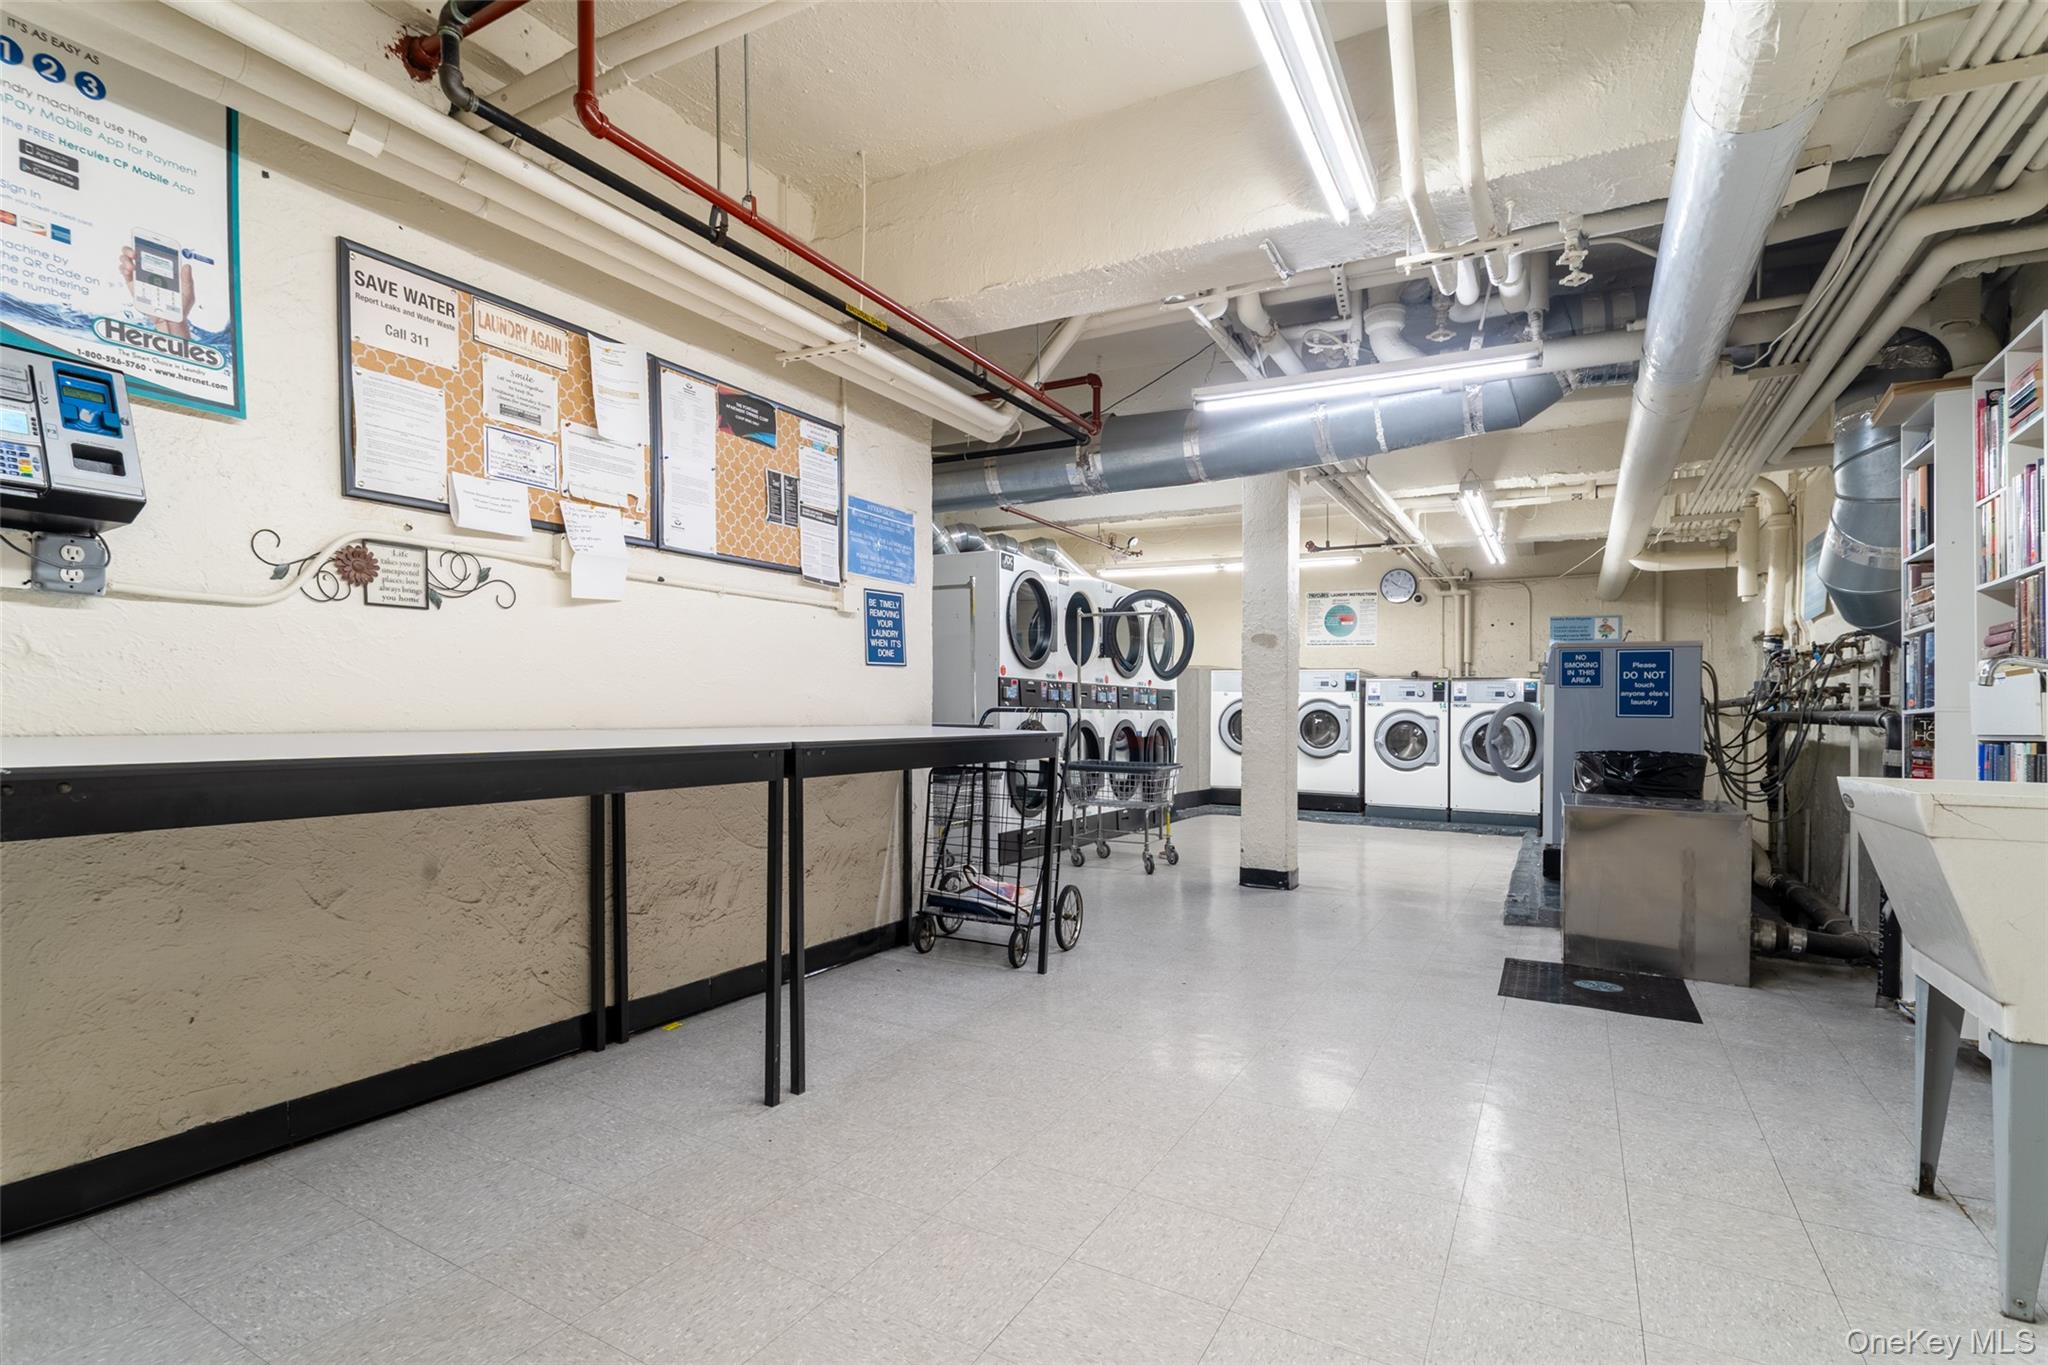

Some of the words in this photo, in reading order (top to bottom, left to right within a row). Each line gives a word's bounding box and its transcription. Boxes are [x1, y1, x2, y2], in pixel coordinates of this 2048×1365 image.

[7, 17, 28, 33] IT'S
[31, 30, 48, 42] AS
[50, 36, 81, 56] EASY
[84, 53, 100, 65] AS
[40, 58, 58, 81] 2
[81, 76, 99, 97] 3
[36, 94, 100, 124] machines
[103, 120, 125, 134] use
[128, 129, 148, 143] the
[40, 108, 93, 137] Mobile
[98, 133, 125, 149] App
[127, 142, 143, 156] for
[146, 150, 198, 177] Payment
[27, 125, 55, 143] FREE
[58, 137, 110, 164] Hercules
[113, 158, 128, 169] CP
[132, 165, 169, 186] Mobile
[172, 181, 196, 196] App
[53, 253, 69, 267] by
[23, 256, 42, 270] QR
[46, 263, 81, 281] Code
[85, 276, 100, 287] on
[23, 281, 72, 301] number
[38, 274, 89, 296] entering
[354, 270, 399, 298] SAVE
[403, 286, 456, 318] WATER
[355, 292, 380, 306] Report
[380, 300, 401, 313] Leaks
[402, 308, 416, 318] and
[417, 312, 436, 326] Water
[436, 319, 456, 331] Waste
[104, 318, 219, 366] Hercules
[385, 323, 407, 340] Call
[410, 331, 430, 347] 311
[478, 310, 528, 343] LAUNDRY
[531, 329, 562, 355] AGAIN
[154, 367, 229, 391] www.hercnet.com
[510, 369, 535, 383] Smile
[382, 594, 397, 602] you
[399, 594, 419, 603] home
[869, 598, 877, 607] BE
[879, 599, 900, 609] TIMELY
[869, 609, 900, 619] REMOVING
[877, 619, 893, 628] YOUR
[870, 638, 888, 647] WHEN
[891, 640, 902, 648] IT'S
[871, 629, 899, 638] LAUNDRY
[877, 649, 895, 657] DONE
[1564, 661, 1599, 669] SMOKING
[1570, 676, 1592, 684] AREA
[1623, 671, 1638, 680] DO
[1643, 671, 1666, 680] NOT
[1630, 698, 1658, 707] laundry
